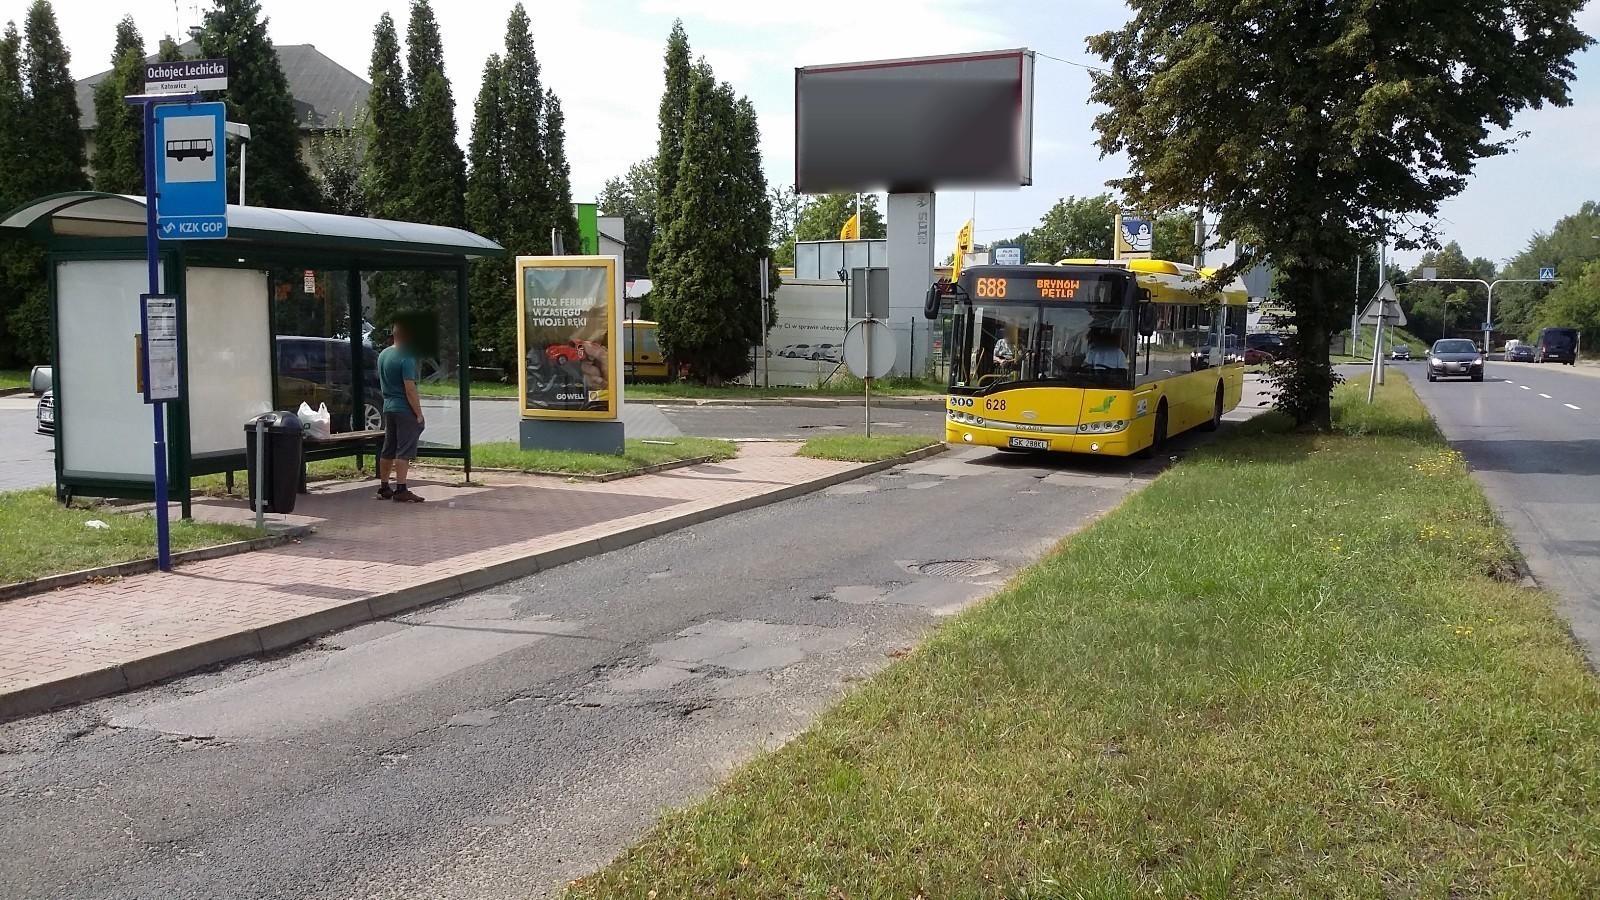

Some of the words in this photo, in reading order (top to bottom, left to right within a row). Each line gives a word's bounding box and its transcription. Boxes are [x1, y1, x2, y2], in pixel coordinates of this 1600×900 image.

[148, 66, 183, 79] Ochojec
[186, 63, 224, 76] Lechicka
[180, 222, 200, 233] KZK
[202, 222, 223, 232] GOP
[977, 278, 1006, 297] 688
[532, 308, 541, 317] W
[543, 308, 581, 318] ZASIĘGU
[533, 318, 566, 327] TWOJEJ
[568, 318, 587, 328] RĘKI
[986, 399, 1006, 410] 628
